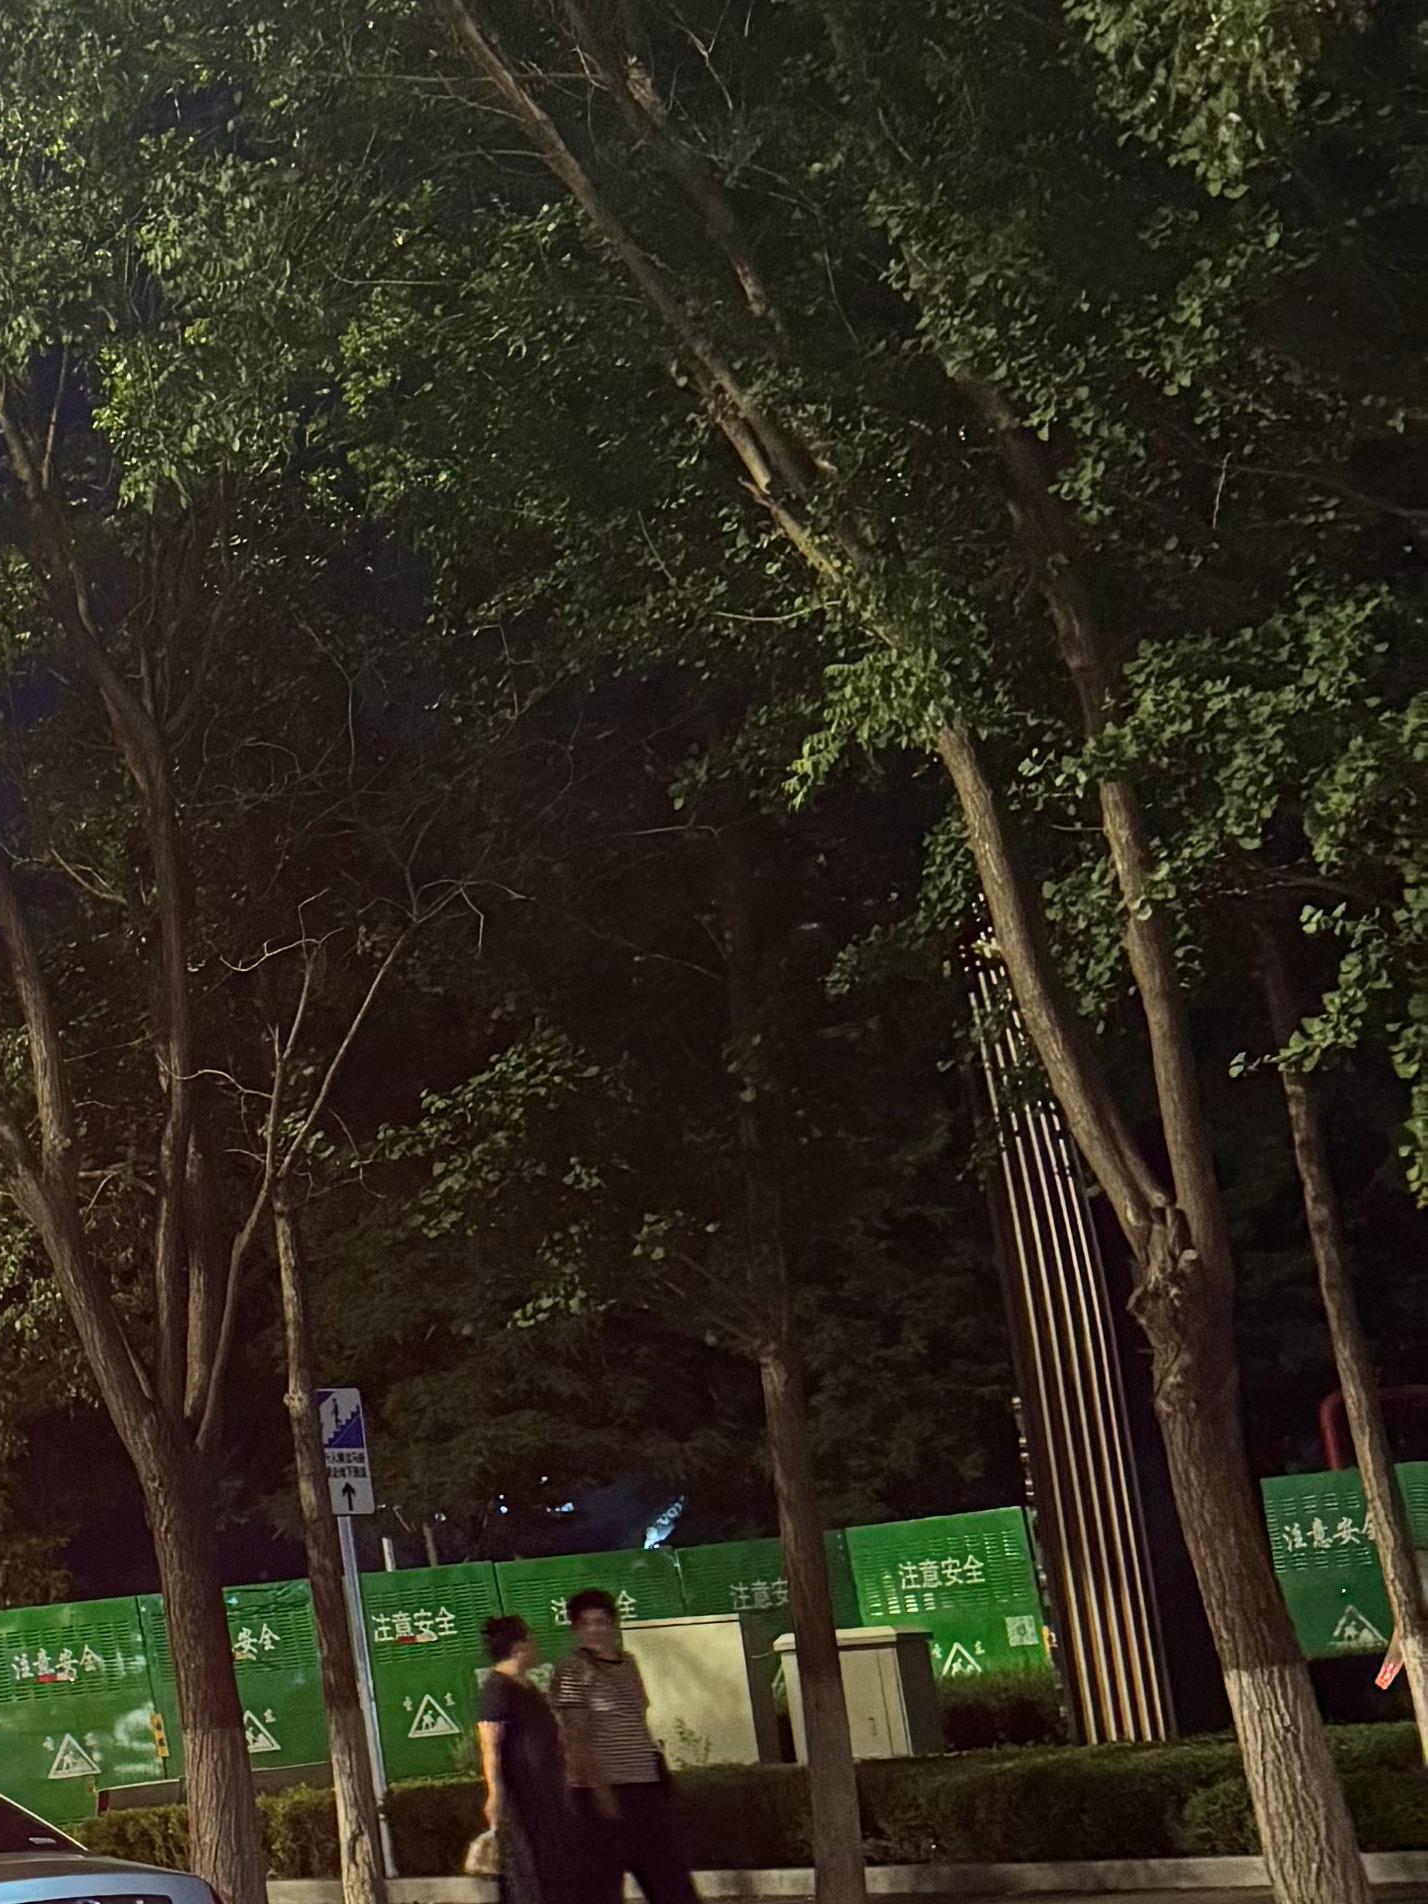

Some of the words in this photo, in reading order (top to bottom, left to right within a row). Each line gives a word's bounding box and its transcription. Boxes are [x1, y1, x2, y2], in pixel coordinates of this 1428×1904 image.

[899, 1554, 985, 1590] 注意安全
[730, 1577, 789, 1611] 注意安
[372, 1606, 458, 1642] 注意安全
[12, 1645, 104, 1681] 注意安全
